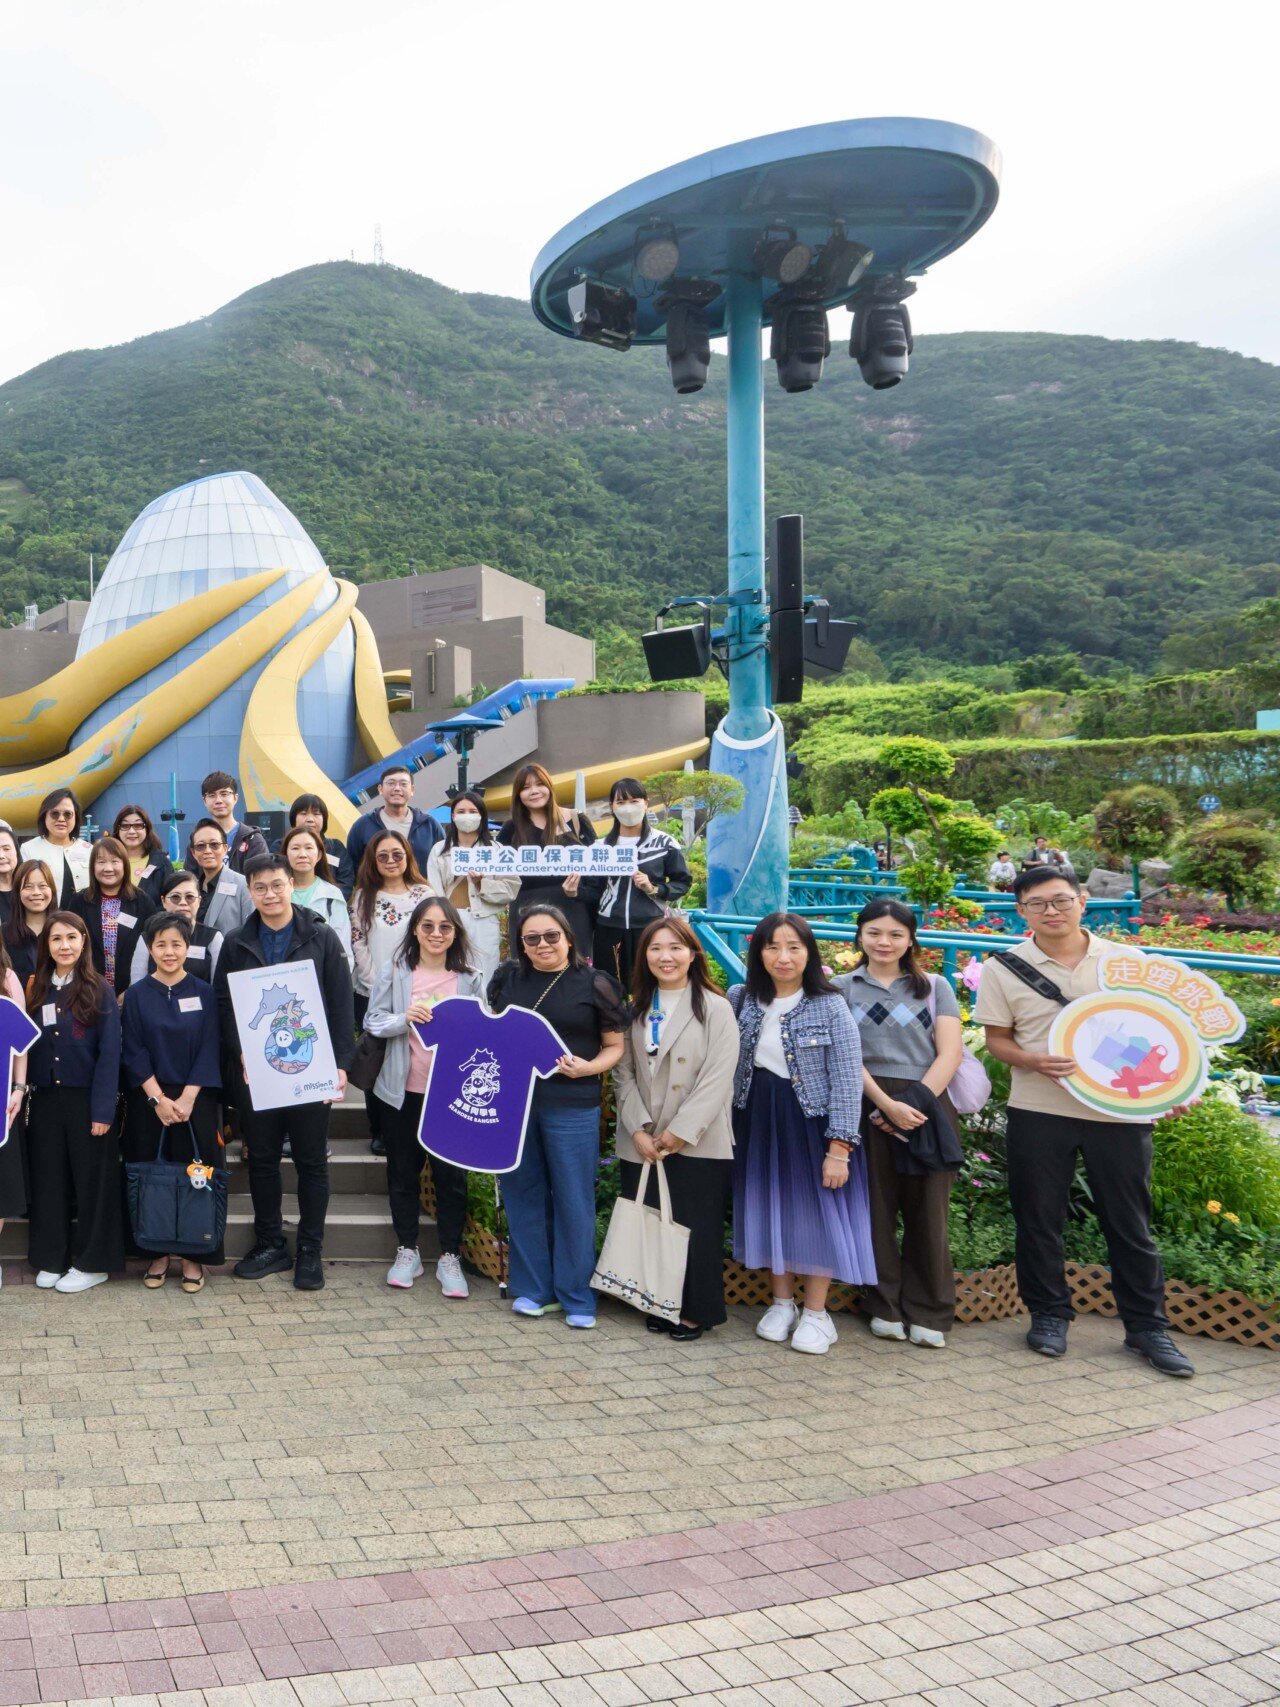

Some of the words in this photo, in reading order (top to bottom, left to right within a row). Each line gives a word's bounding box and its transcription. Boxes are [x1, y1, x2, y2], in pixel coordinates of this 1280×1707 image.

[454, 848, 634, 863] 海洋公園保育聯盟
[455, 865, 488, 873] Ocean
[489, 865, 513, 873] Park
[515, 864, 587, 873] Conservation
[589, 864, 634, 873] Alliance
[1109, 960, 1232, 1032] 走塑挑戰
